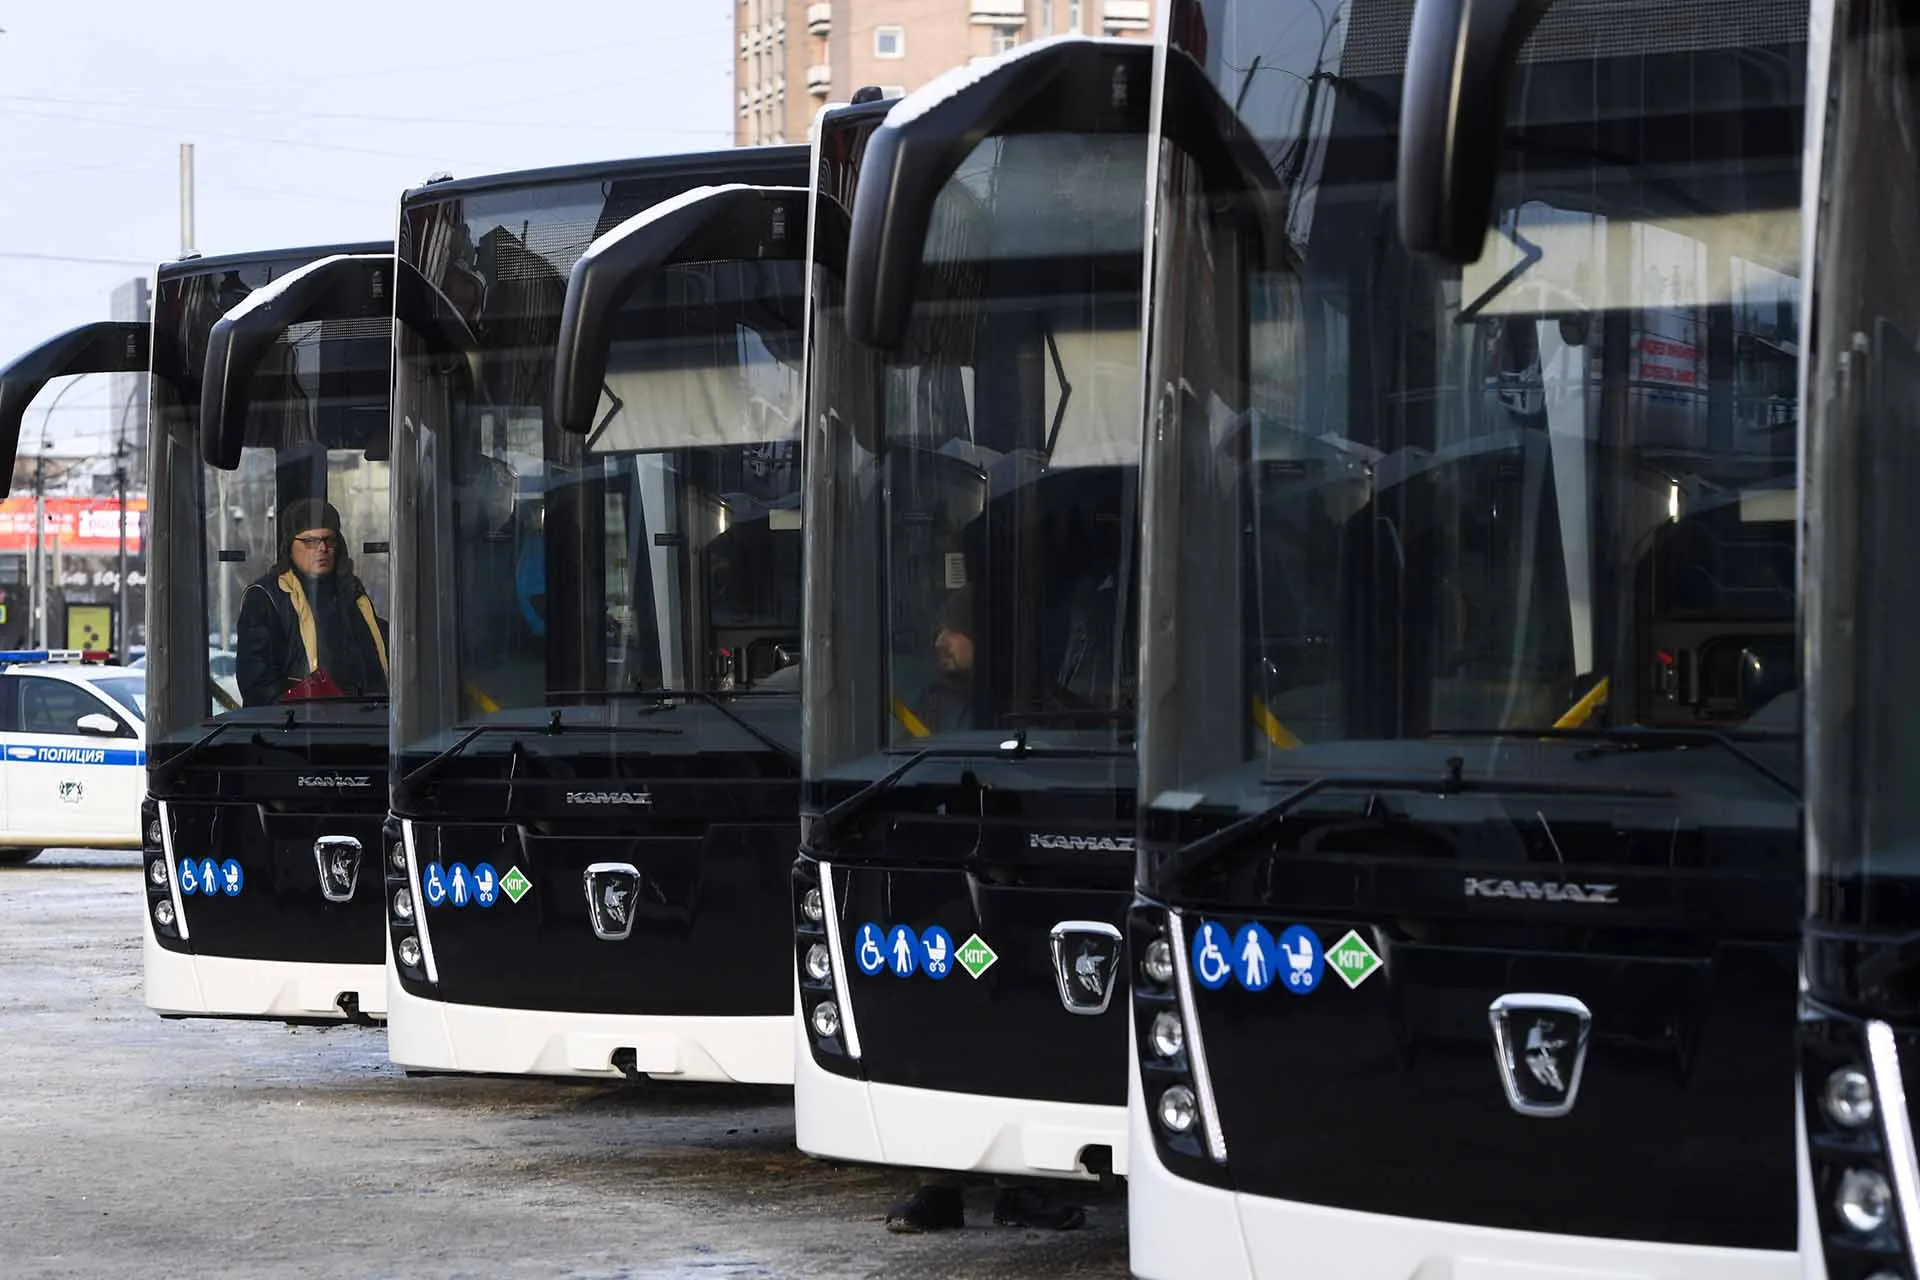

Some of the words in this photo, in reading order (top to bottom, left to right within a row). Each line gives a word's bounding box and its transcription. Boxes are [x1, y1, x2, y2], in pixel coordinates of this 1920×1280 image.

[38, 748, 105, 764] ПОЛИЦИЯ
[566, 792, 652, 804] KAMAZ
[1030, 833, 1136, 851] KAMAZ
[506, 878, 524, 890] КПГ
[1464, 878, 1619, 903] KAMAZ
[964, 948, 988, 964] КПГ
[1338, 949, 1369, 970] КПГ
